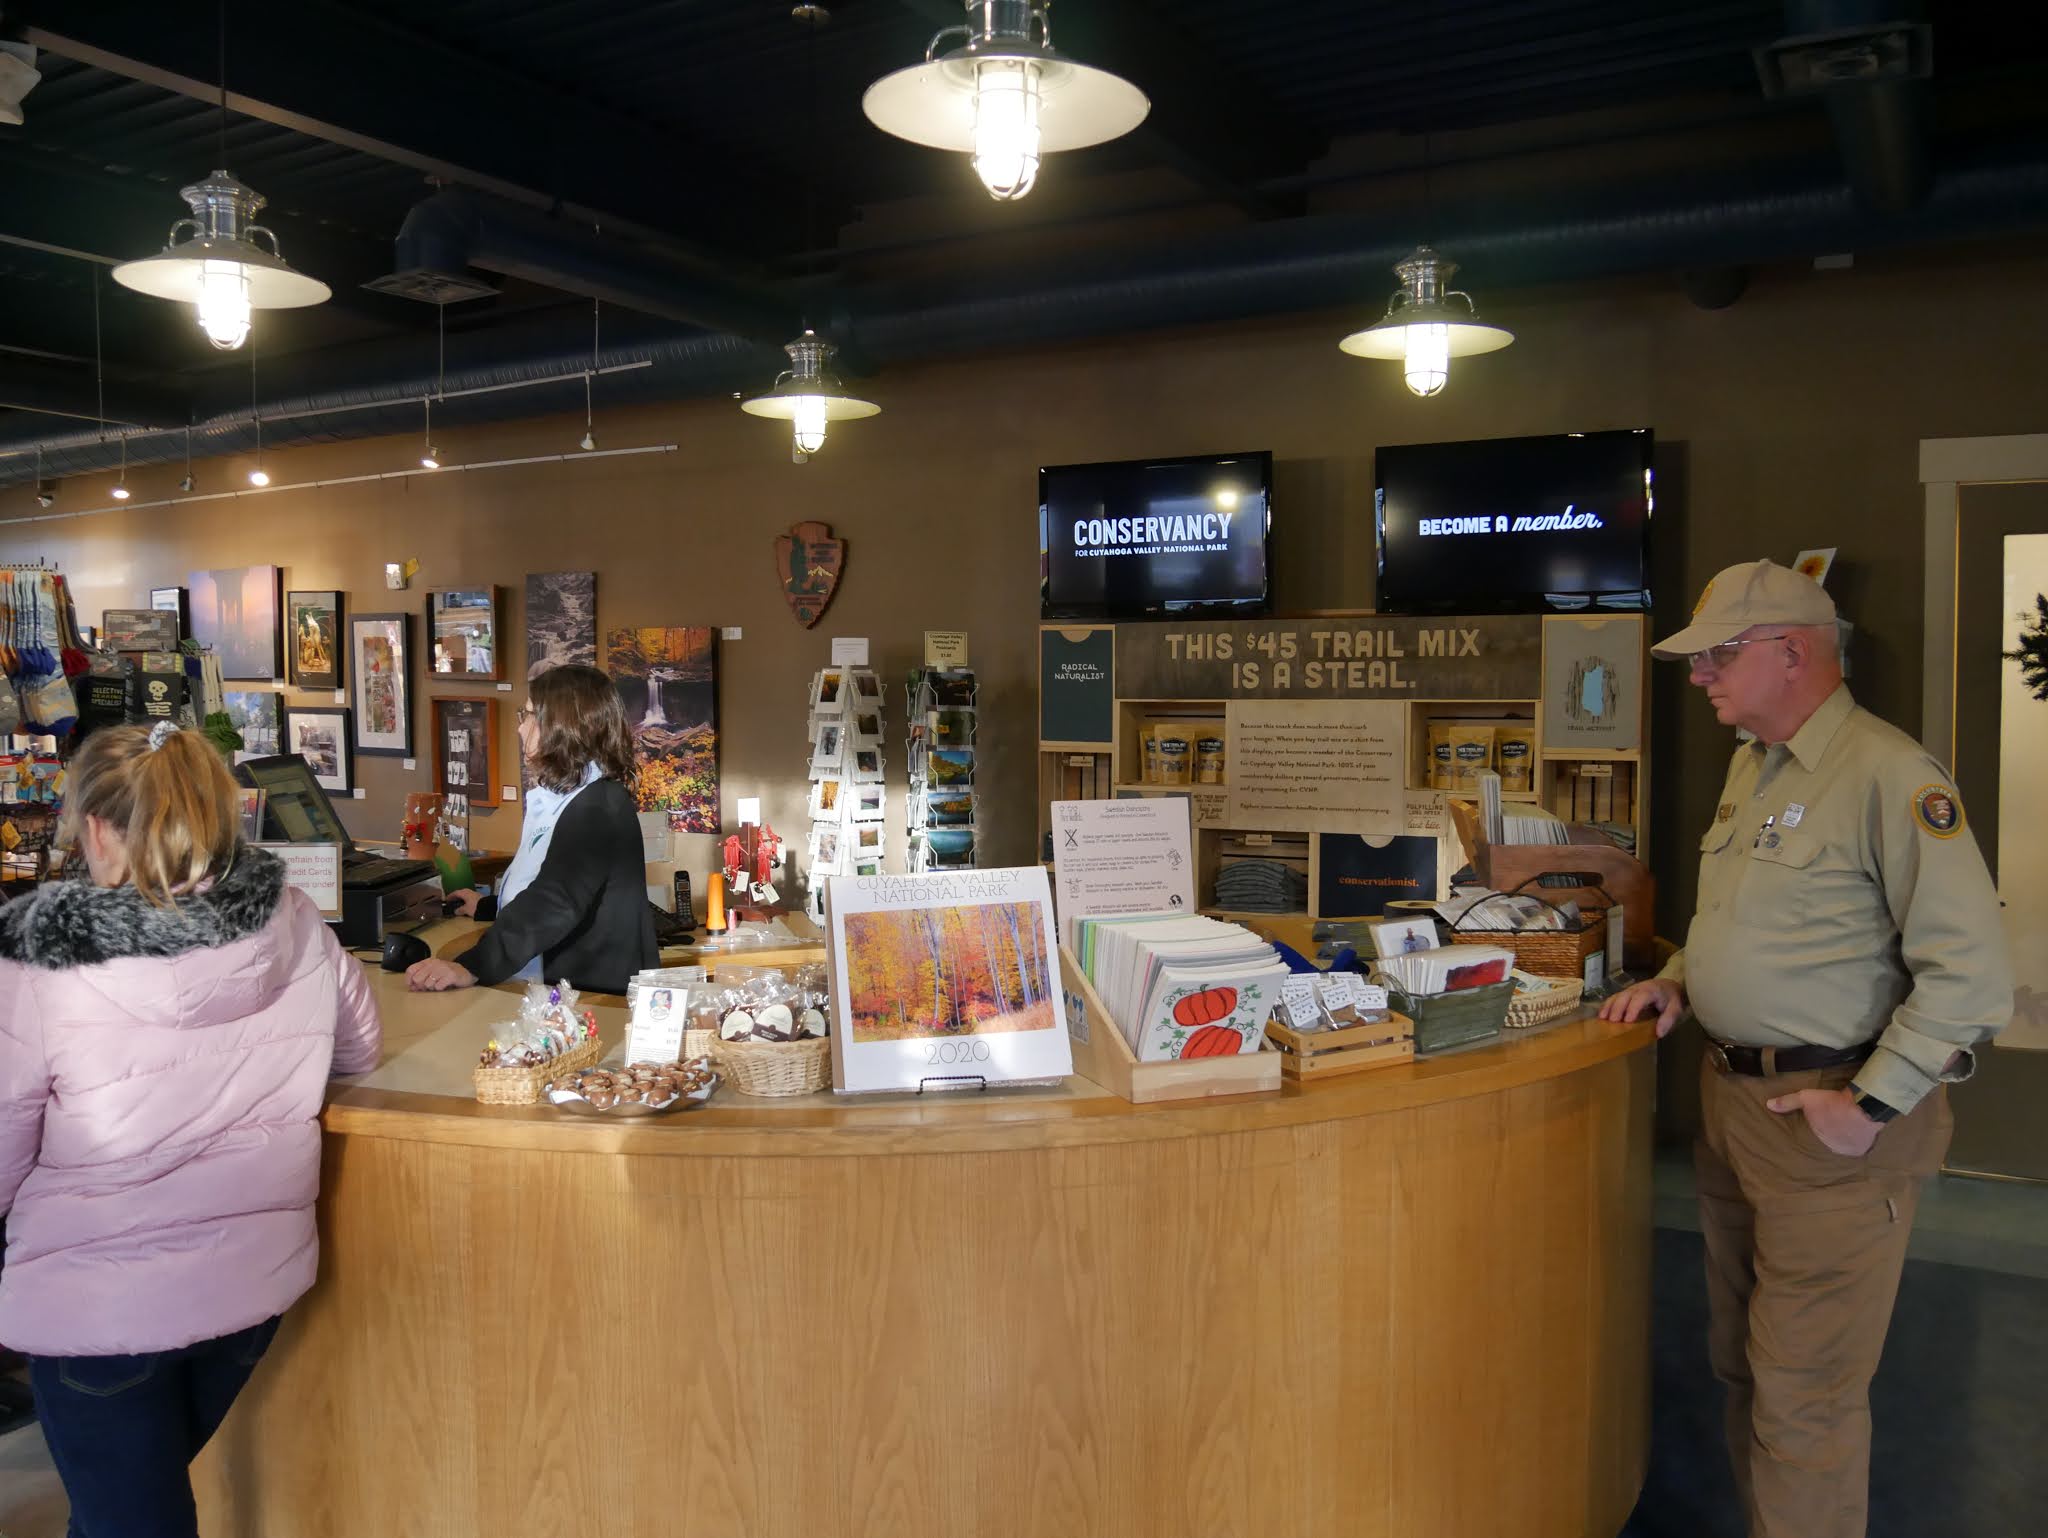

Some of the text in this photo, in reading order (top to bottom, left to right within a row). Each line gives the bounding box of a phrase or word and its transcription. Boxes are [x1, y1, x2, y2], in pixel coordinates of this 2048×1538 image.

[1074, 513, 1232, 546] CONSERVANCY
[1419, 505, 1603, 536] BECOME A member.
[1075, 543, 1228, 557] FOR CUYAHOGA VALLEY NATIONAL PARK
[1165, 629, 1480, 660] THIS $45 TRAIL MIX
[1054, 672, 1105, 682] NATURALIST
[1061, 663, 1098, 673] RADICAL
[1232, 661, 1416, 689] IS A STEAL.
[308, 868, 332, 876] Cards
[857, 870, 1020, 890] CUYAHOGA VALLEY
[1338, 875, 1420, 888] conservationist.
[874, 883, 1009, 904] NATIONAL PARK
[924, 1041, 990, 1065] 2020
